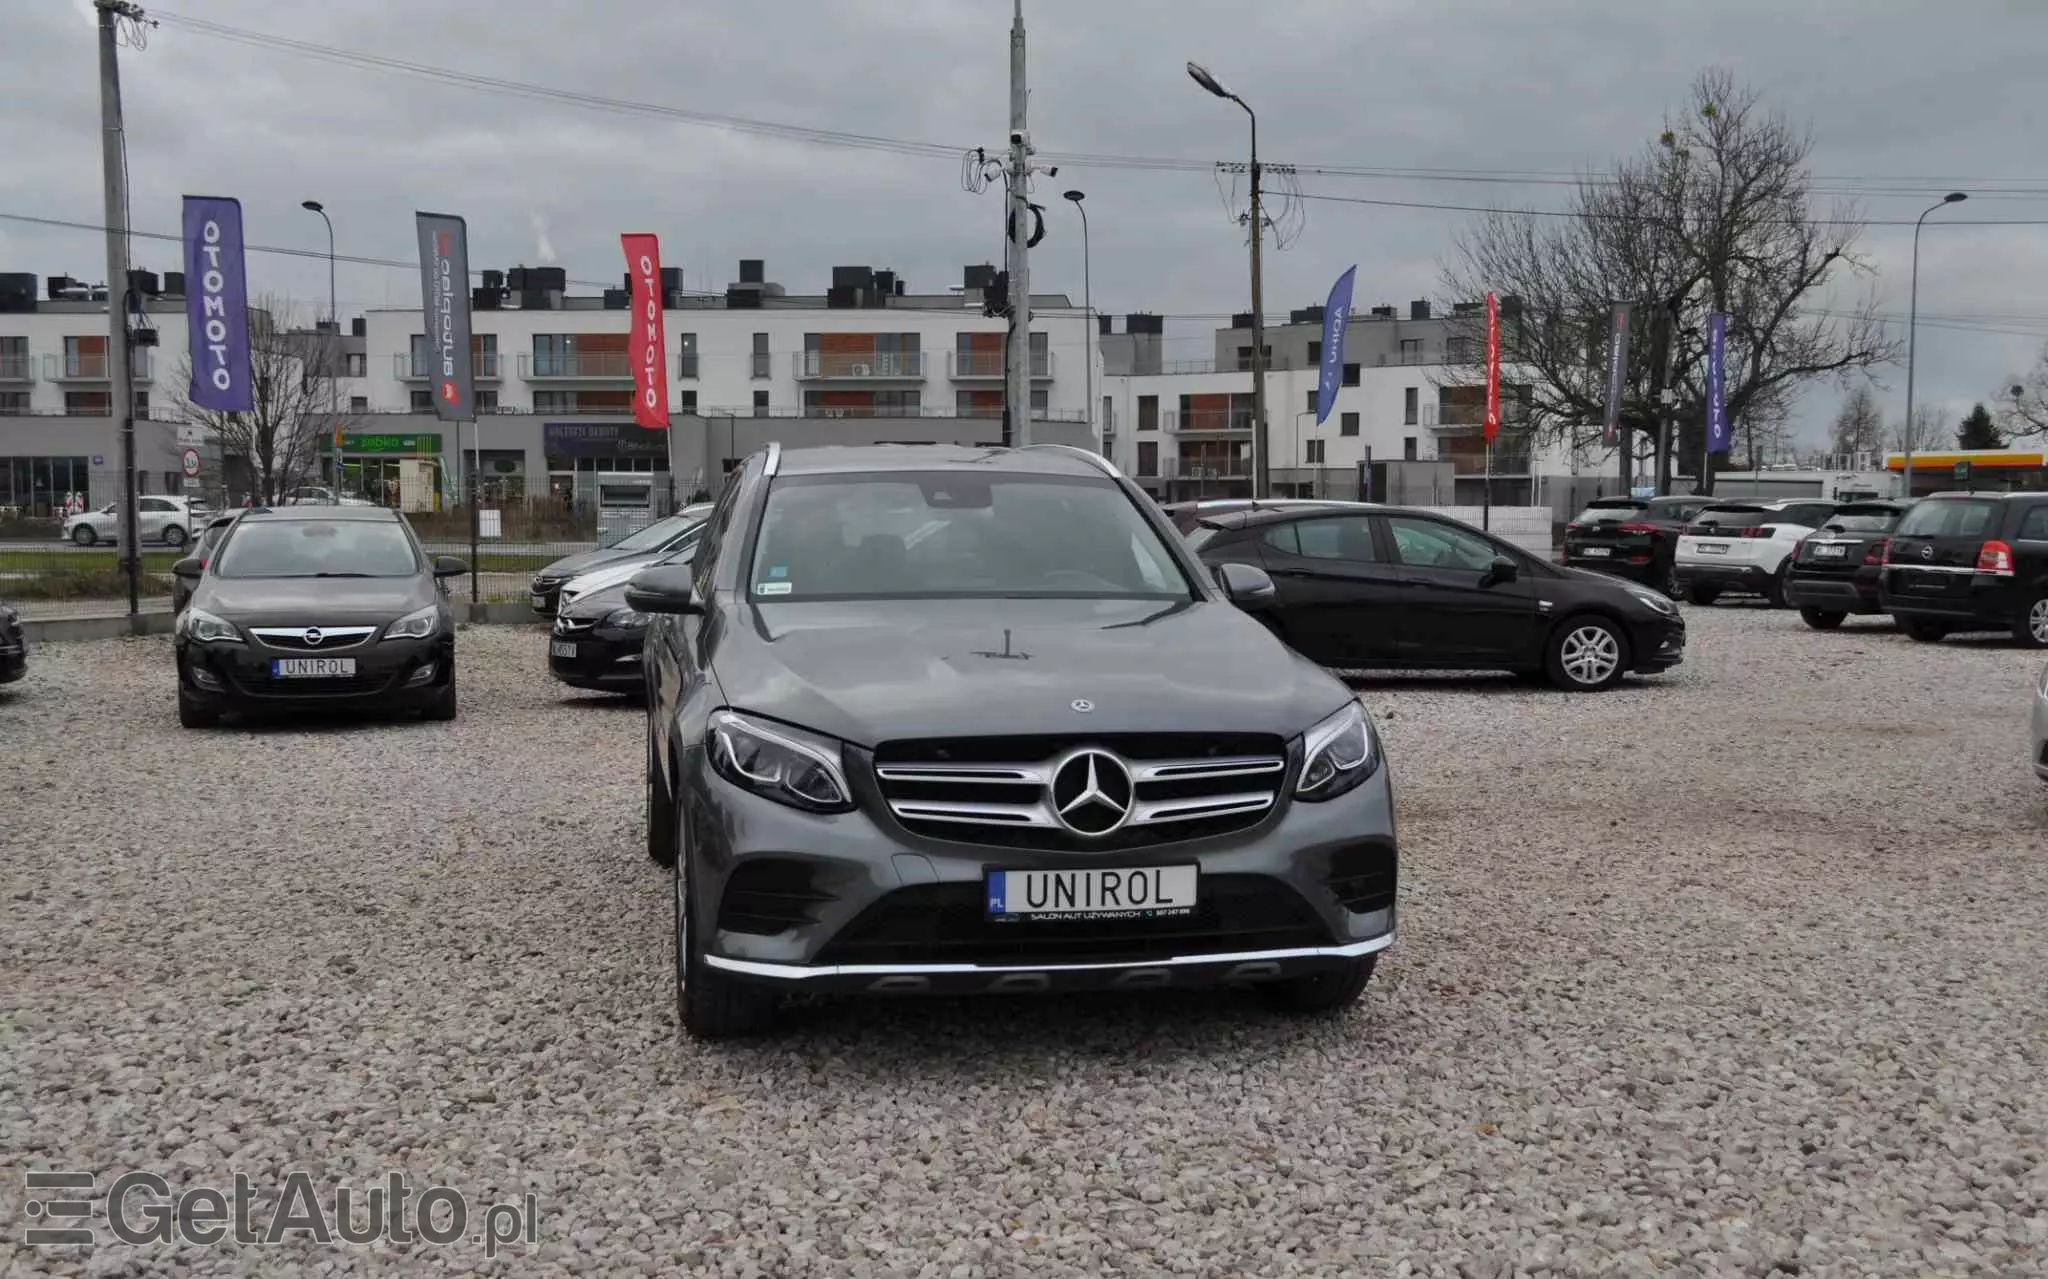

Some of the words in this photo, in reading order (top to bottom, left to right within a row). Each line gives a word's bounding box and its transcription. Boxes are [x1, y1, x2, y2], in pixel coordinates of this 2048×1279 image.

[203, 220, 230, 391] OTOMOTO
[640, 255, 657, 408] OTOMOTO
[286, 660, 349, 674] UNIROL
[1026, 869, 1174, 908] UNIROL
